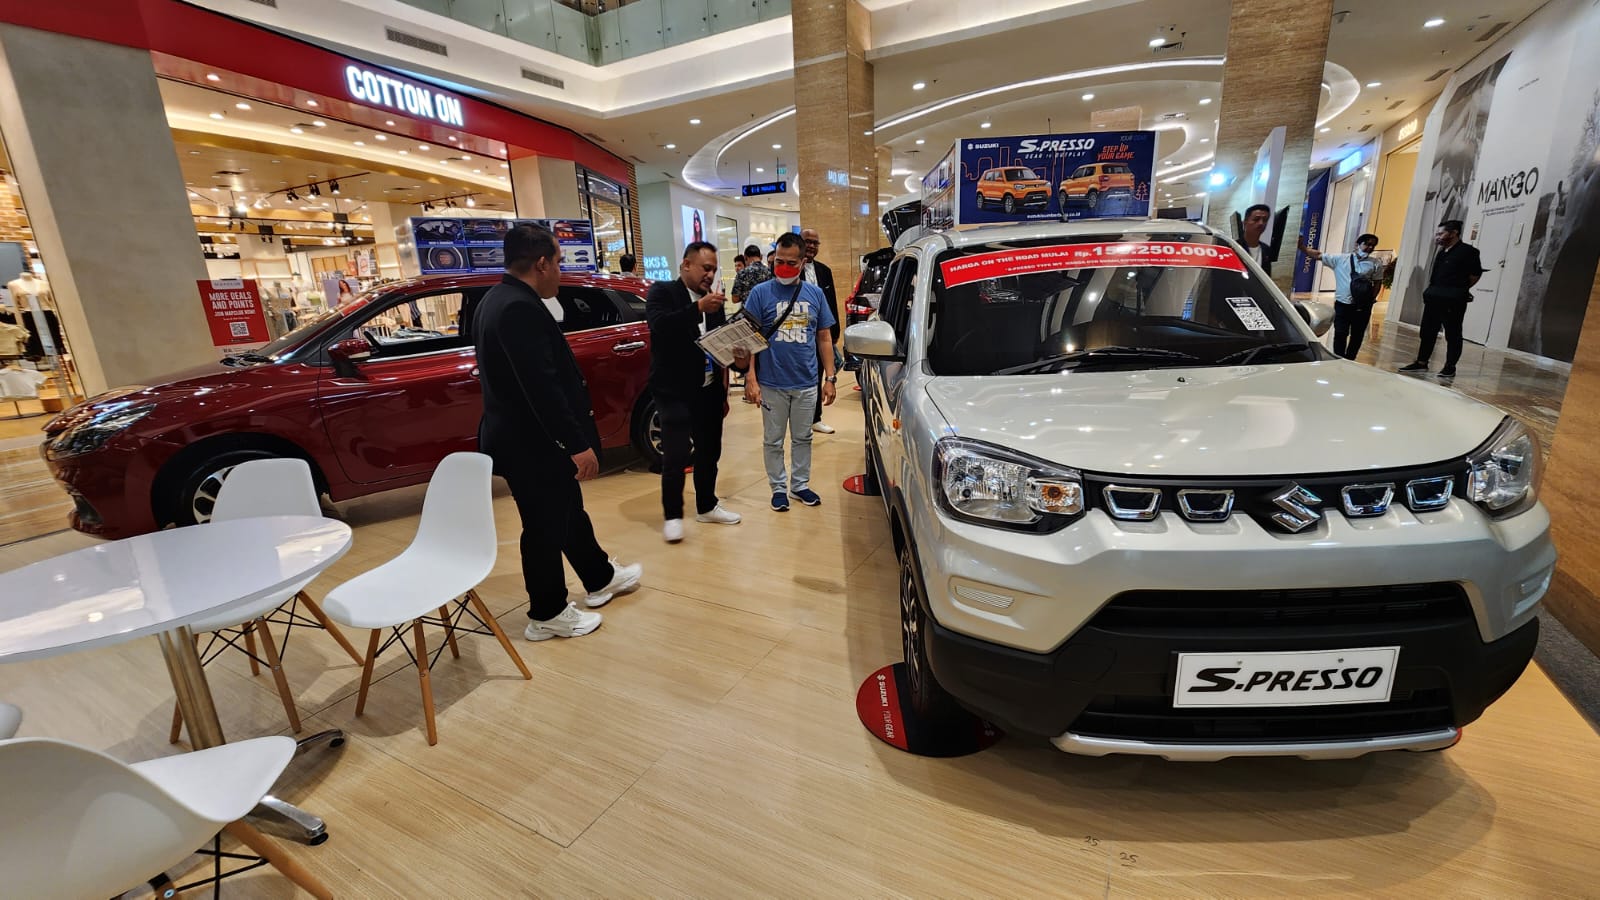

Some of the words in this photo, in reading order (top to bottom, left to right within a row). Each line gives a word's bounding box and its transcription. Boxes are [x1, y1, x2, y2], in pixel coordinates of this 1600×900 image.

[346, 65, 434, 118] COTTON
[435, 93, 464, 126] ON
[1102, 145, 1119, 153] STEP
[1119, 143, 1129, 152] UP
[1097, 153, 1116, 161] YOUR
[1477, 167, 1539, 205] MANGO
[950, 262, 980, 272] HARGA
[209, 292, 229, 301] MORE
[230, 291, 252, 300] DEALS
[212, 301, 227, 310] AND
[228, 300, 254, 309] POINTS
[878, 681, 889, 707] SUZUKI
[885, 723, 895, 739] GEAR
[1084, 835, 1100, 847] 25
[1120, 852, 1139, 863] 25
